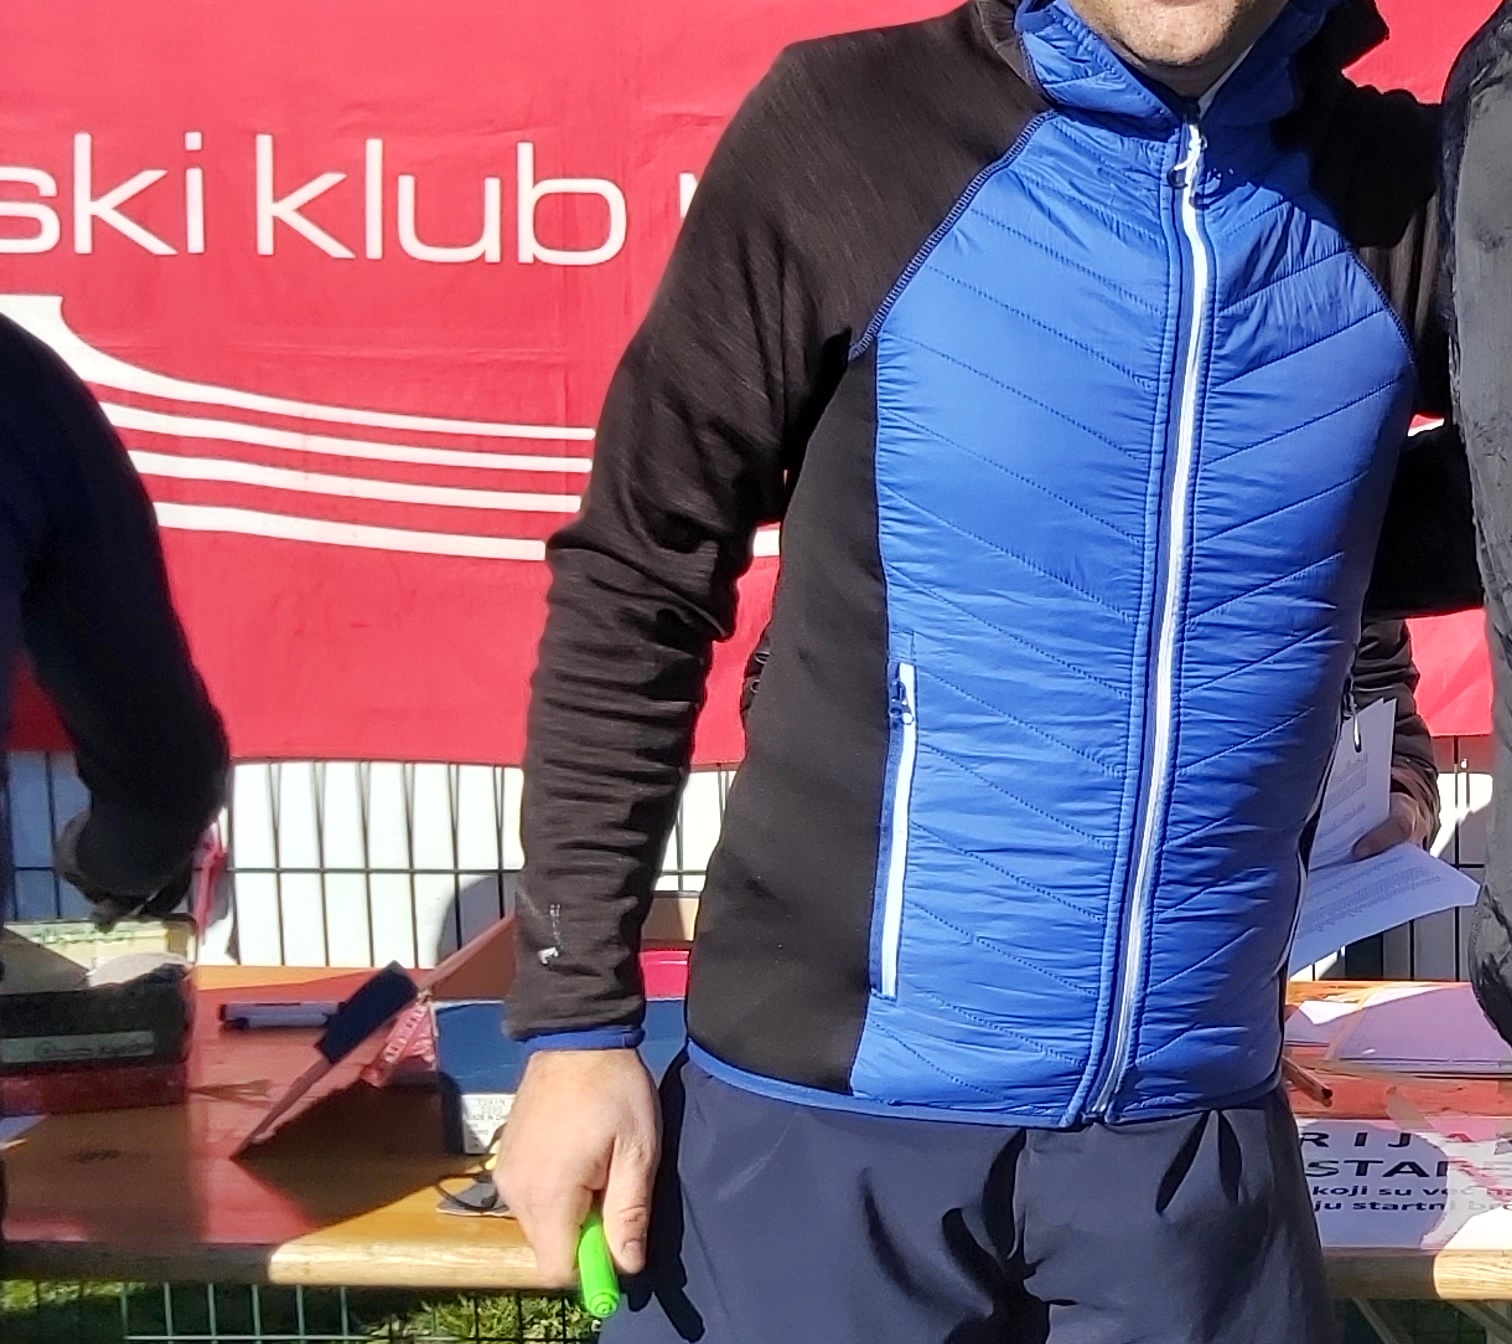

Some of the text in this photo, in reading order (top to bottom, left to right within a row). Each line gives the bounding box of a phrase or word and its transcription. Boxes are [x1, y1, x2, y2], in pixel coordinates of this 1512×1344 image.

[255, 133, 628, 265] klub
[1312, 1185, 1368, 1197] koji
[1378, 1188, 1412, 1196] su
[1314, 1201, 1342, 1212] ju
